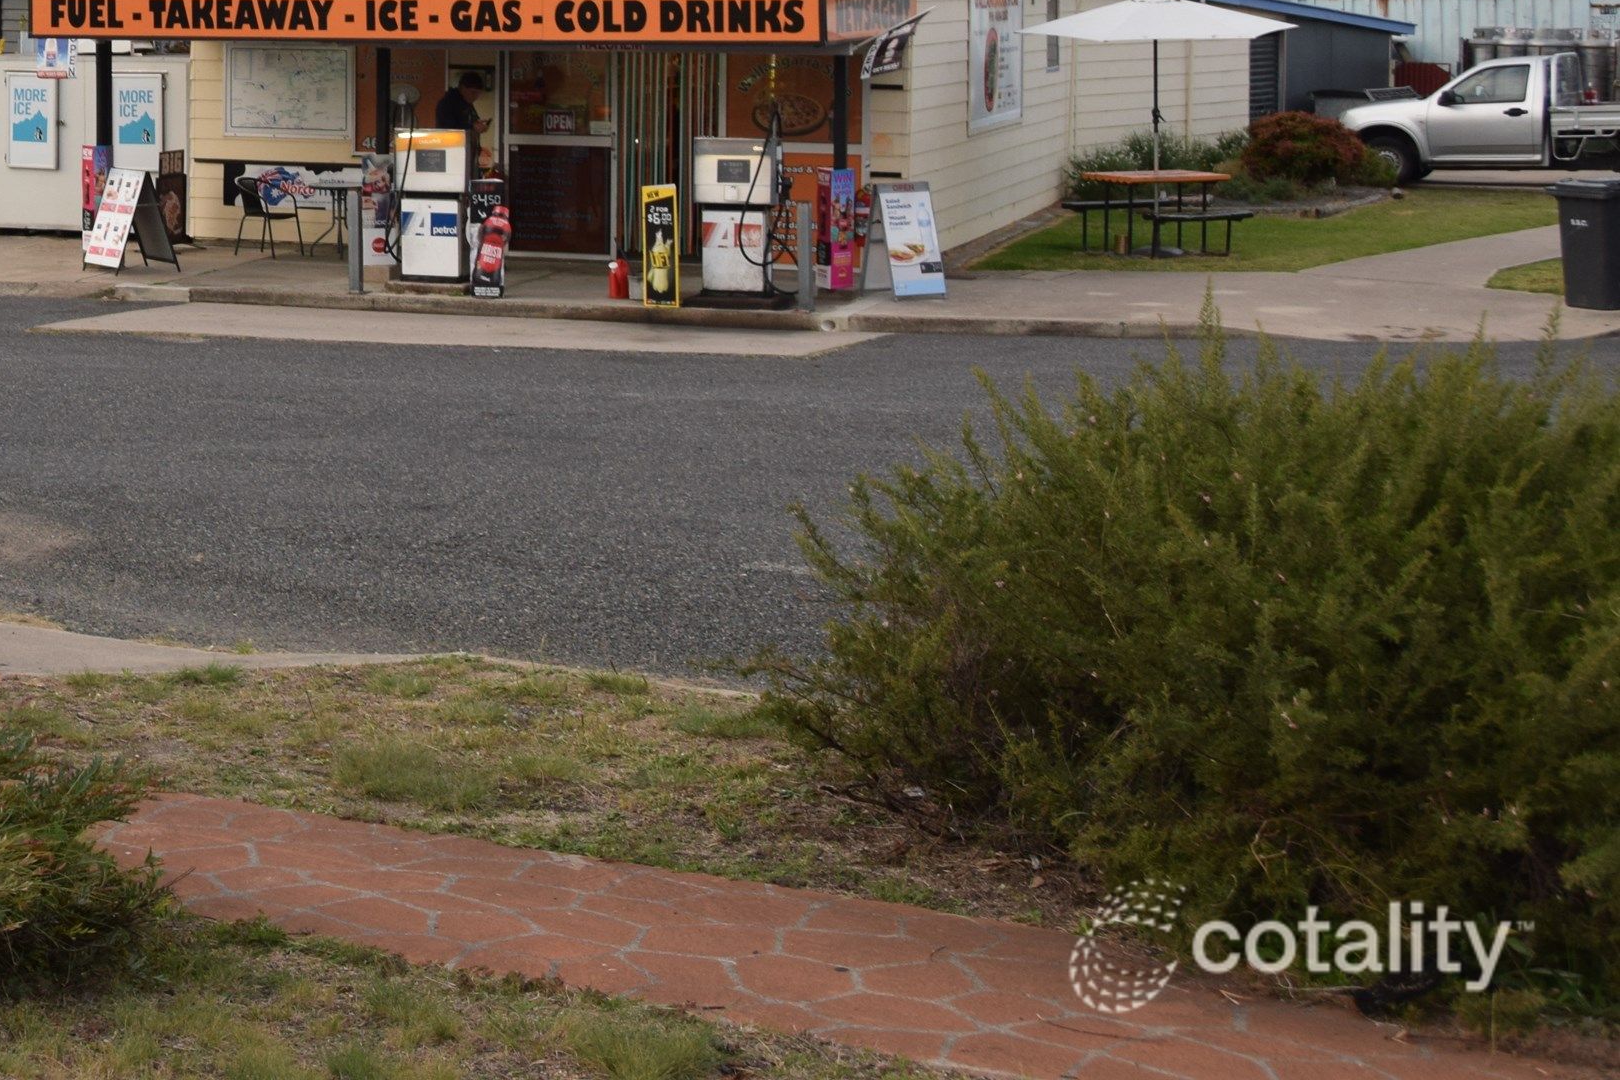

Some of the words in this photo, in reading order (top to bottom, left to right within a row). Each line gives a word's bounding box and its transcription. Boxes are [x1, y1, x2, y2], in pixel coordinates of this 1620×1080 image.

[366, 0, 419, 31] ICE
[450, 0, 522, 32] GAS
[554, 0, 648, 32] COLD
[659, 0, 805, 33] DRINKS
[13, 88, 47, 102] MORE
[119, 90, 154, 103] MORE
[13, 101, 32, 115] ICE
[119, 104, 138, 117] ICE
[546, 113, 573, 130] OPEN
[432, 223, 457, 236] petrol
